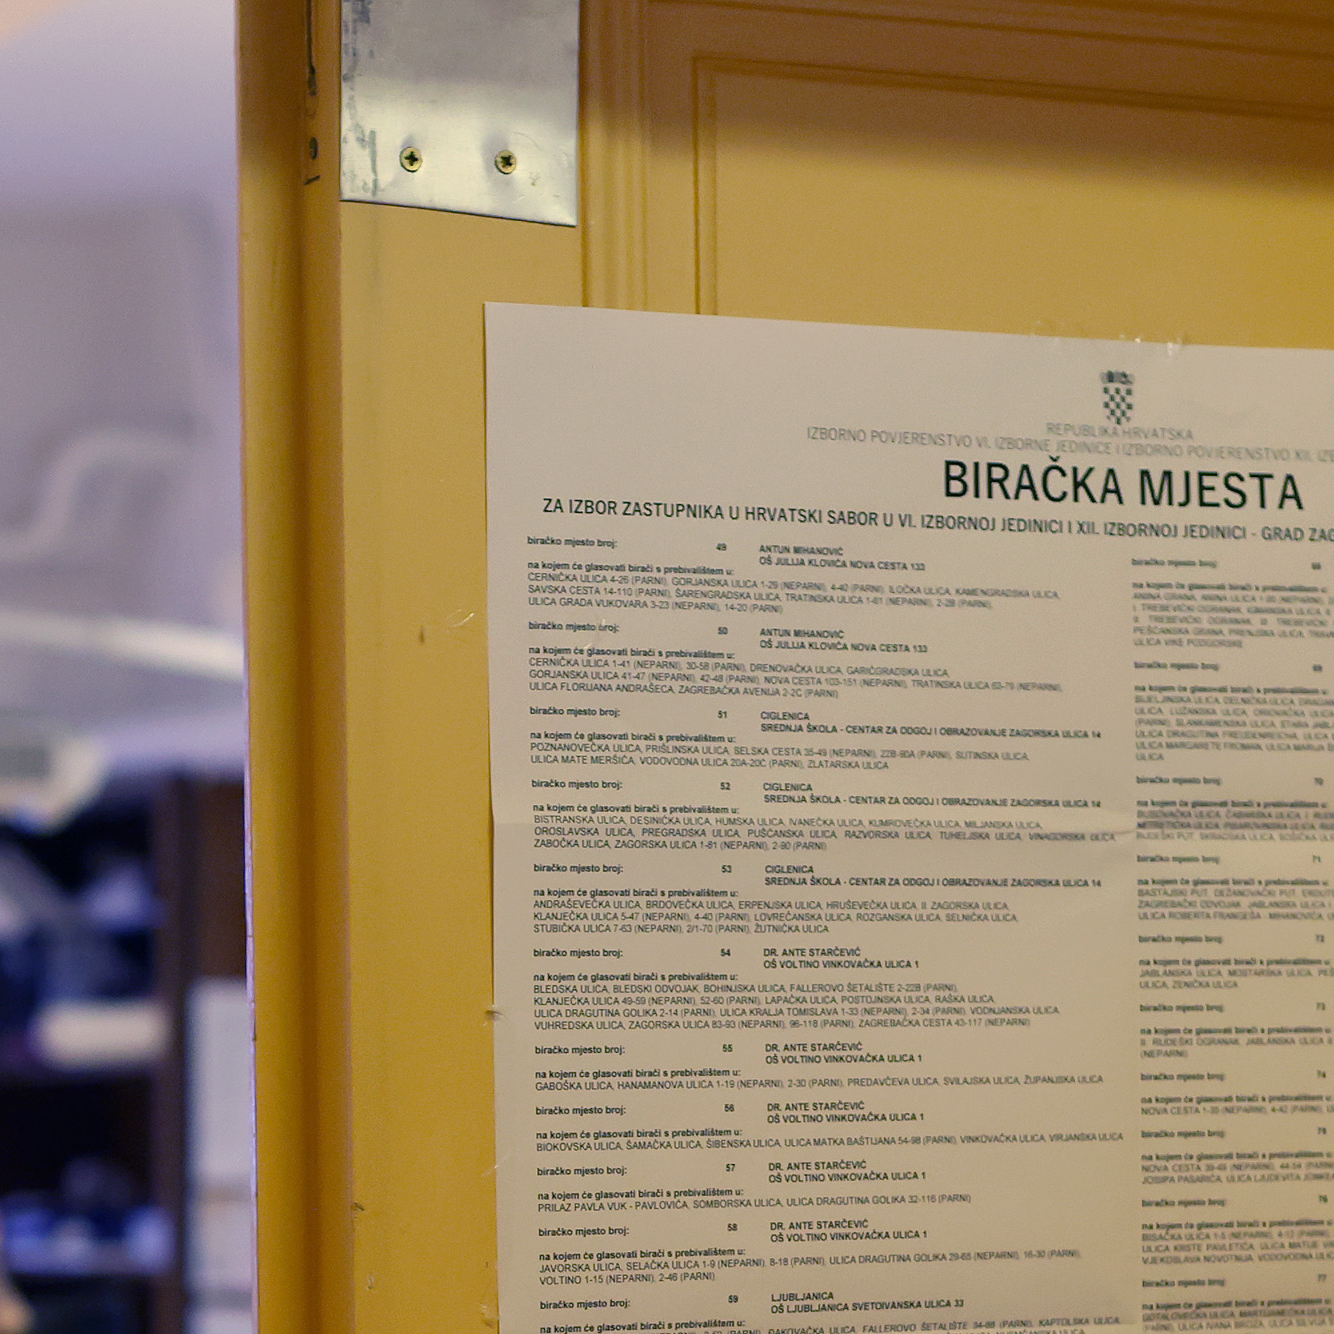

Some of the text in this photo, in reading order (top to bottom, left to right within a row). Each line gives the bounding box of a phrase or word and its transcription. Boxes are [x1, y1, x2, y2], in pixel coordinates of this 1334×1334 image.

[944, 456, 1303, 510] BIRAČKA MJESTA
[542, 497, 563, 512] ZA
[568, 498, 617, 515] IZBOR
[621, 500, 724, 519] ZASTUPNIKA
[728, 505, 739, 520] U
[744, 506, 822, 523] HRVATSKI
[826, 509, 878, 526] SABOR
[882, 512, 893, 527] U
[897, 512, 916, 528] VI.
[920, 514, 995, 531] IZBORNOJ
[1000, 517, 1063, 534] JEDINICI
[1076, 520, 1099, 535] XII.
[1103, 521, 1178, 538] IZBORNOJ
[1182, 523, 1246, 540] JEDINICI
[1260, 525, 1304, 542] GRAD
[526, 536, 562, 545] biračko
[563, 538, 595, 546] mjesto
[596, 539, 617, 548] broj:
[758, 544, 843, 556] ANTUN MIHANOVIĆ
[758, 555, 772, 565] OŠ
[807, 558, 847, 568] KLOVIĆA
[849, 560, 875, 569] NOVA
[876, 560, 908, 570] CESTA
[760, 710, 810, 720] CIGLENICA
[764, 876, 807, 885] SREDNJA
[809, 876, 841, 886] ŠKOLA
[848, 876, 886, 886] CENTAR
[887, 877, 900, 886] ZA
[902, 877, 934, 886] ODGOJ
[941, 877, 1008, 887] OBRAZOVANJE
[1010, 878, 1060, 887] ZAGORSKA
[1061, 878, 1089, 887] ULICA
[1091, 879, 1101, 887] 14
[632, 888, 657, 896] birači
[667, 889, 728, 897] prebivalištem
[533, 923, 580, 933] STUBIČKA
[582, 923, 611, 933] ULICA
[613, 923, 632, 932] 7-63
[686, 923, 713, 933] 2/1-70
[753, 923, 800, 933] ŽUTNIČKA
[801, 924, 829, 933] ULICA
[533, 948, 730, 957] biračko mjesto broj: 54
[763, 947, 860, 957] DR. ANTE STARČEVIĆ
[763, 958, 777, 968] OŠ
[778, 959, 819, 968] VOLTINO
[821, 959, 882, 968] VINKOVAČKA
[884, 959, 911, 968] ULICA
[539, 1294, 738, 1309] biračko mjesto broj: 59
[770, 1291, 834, 1302] LJUBLJANICA
